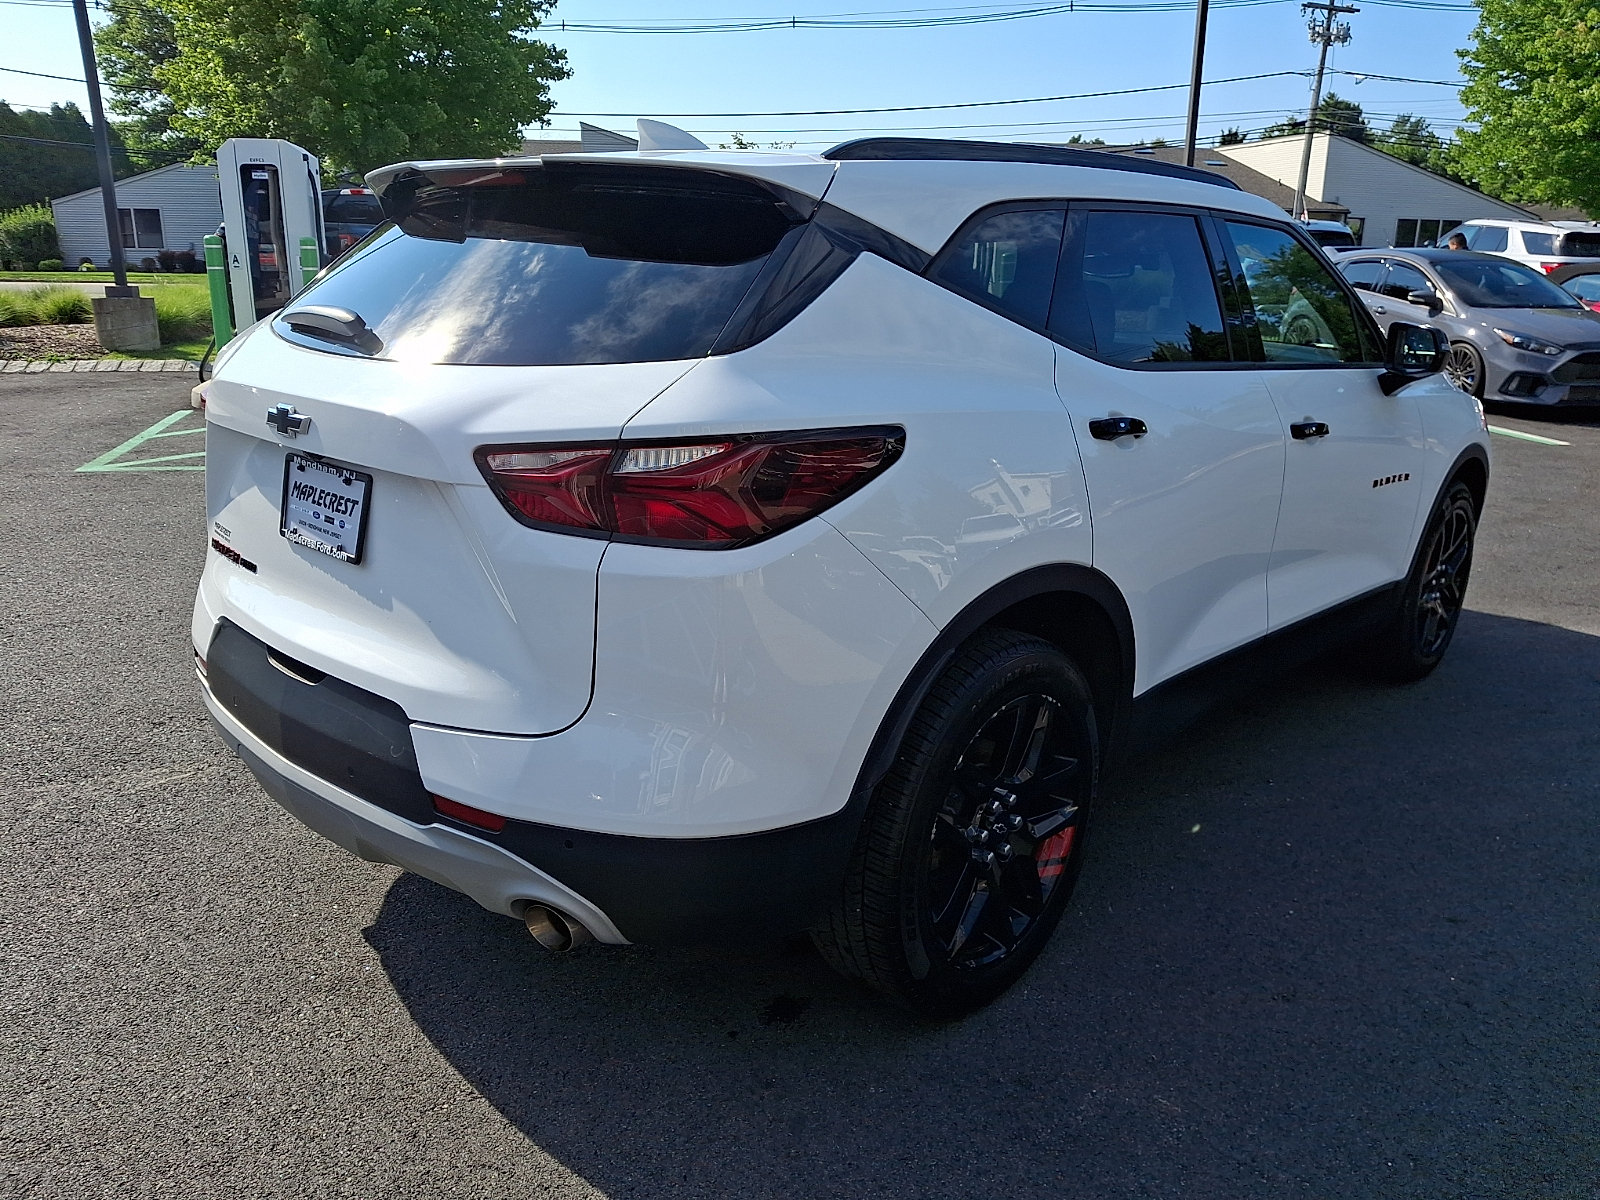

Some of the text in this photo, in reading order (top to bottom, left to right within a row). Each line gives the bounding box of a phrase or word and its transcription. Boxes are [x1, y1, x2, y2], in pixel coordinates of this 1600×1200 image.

[232, 254, 240, 265] A
[293, 456, 356, 480] Mendham, NJ
[1372, 473, 1410, 488] BLAZER
[291, 480, 359, 517] MAPLECREST
